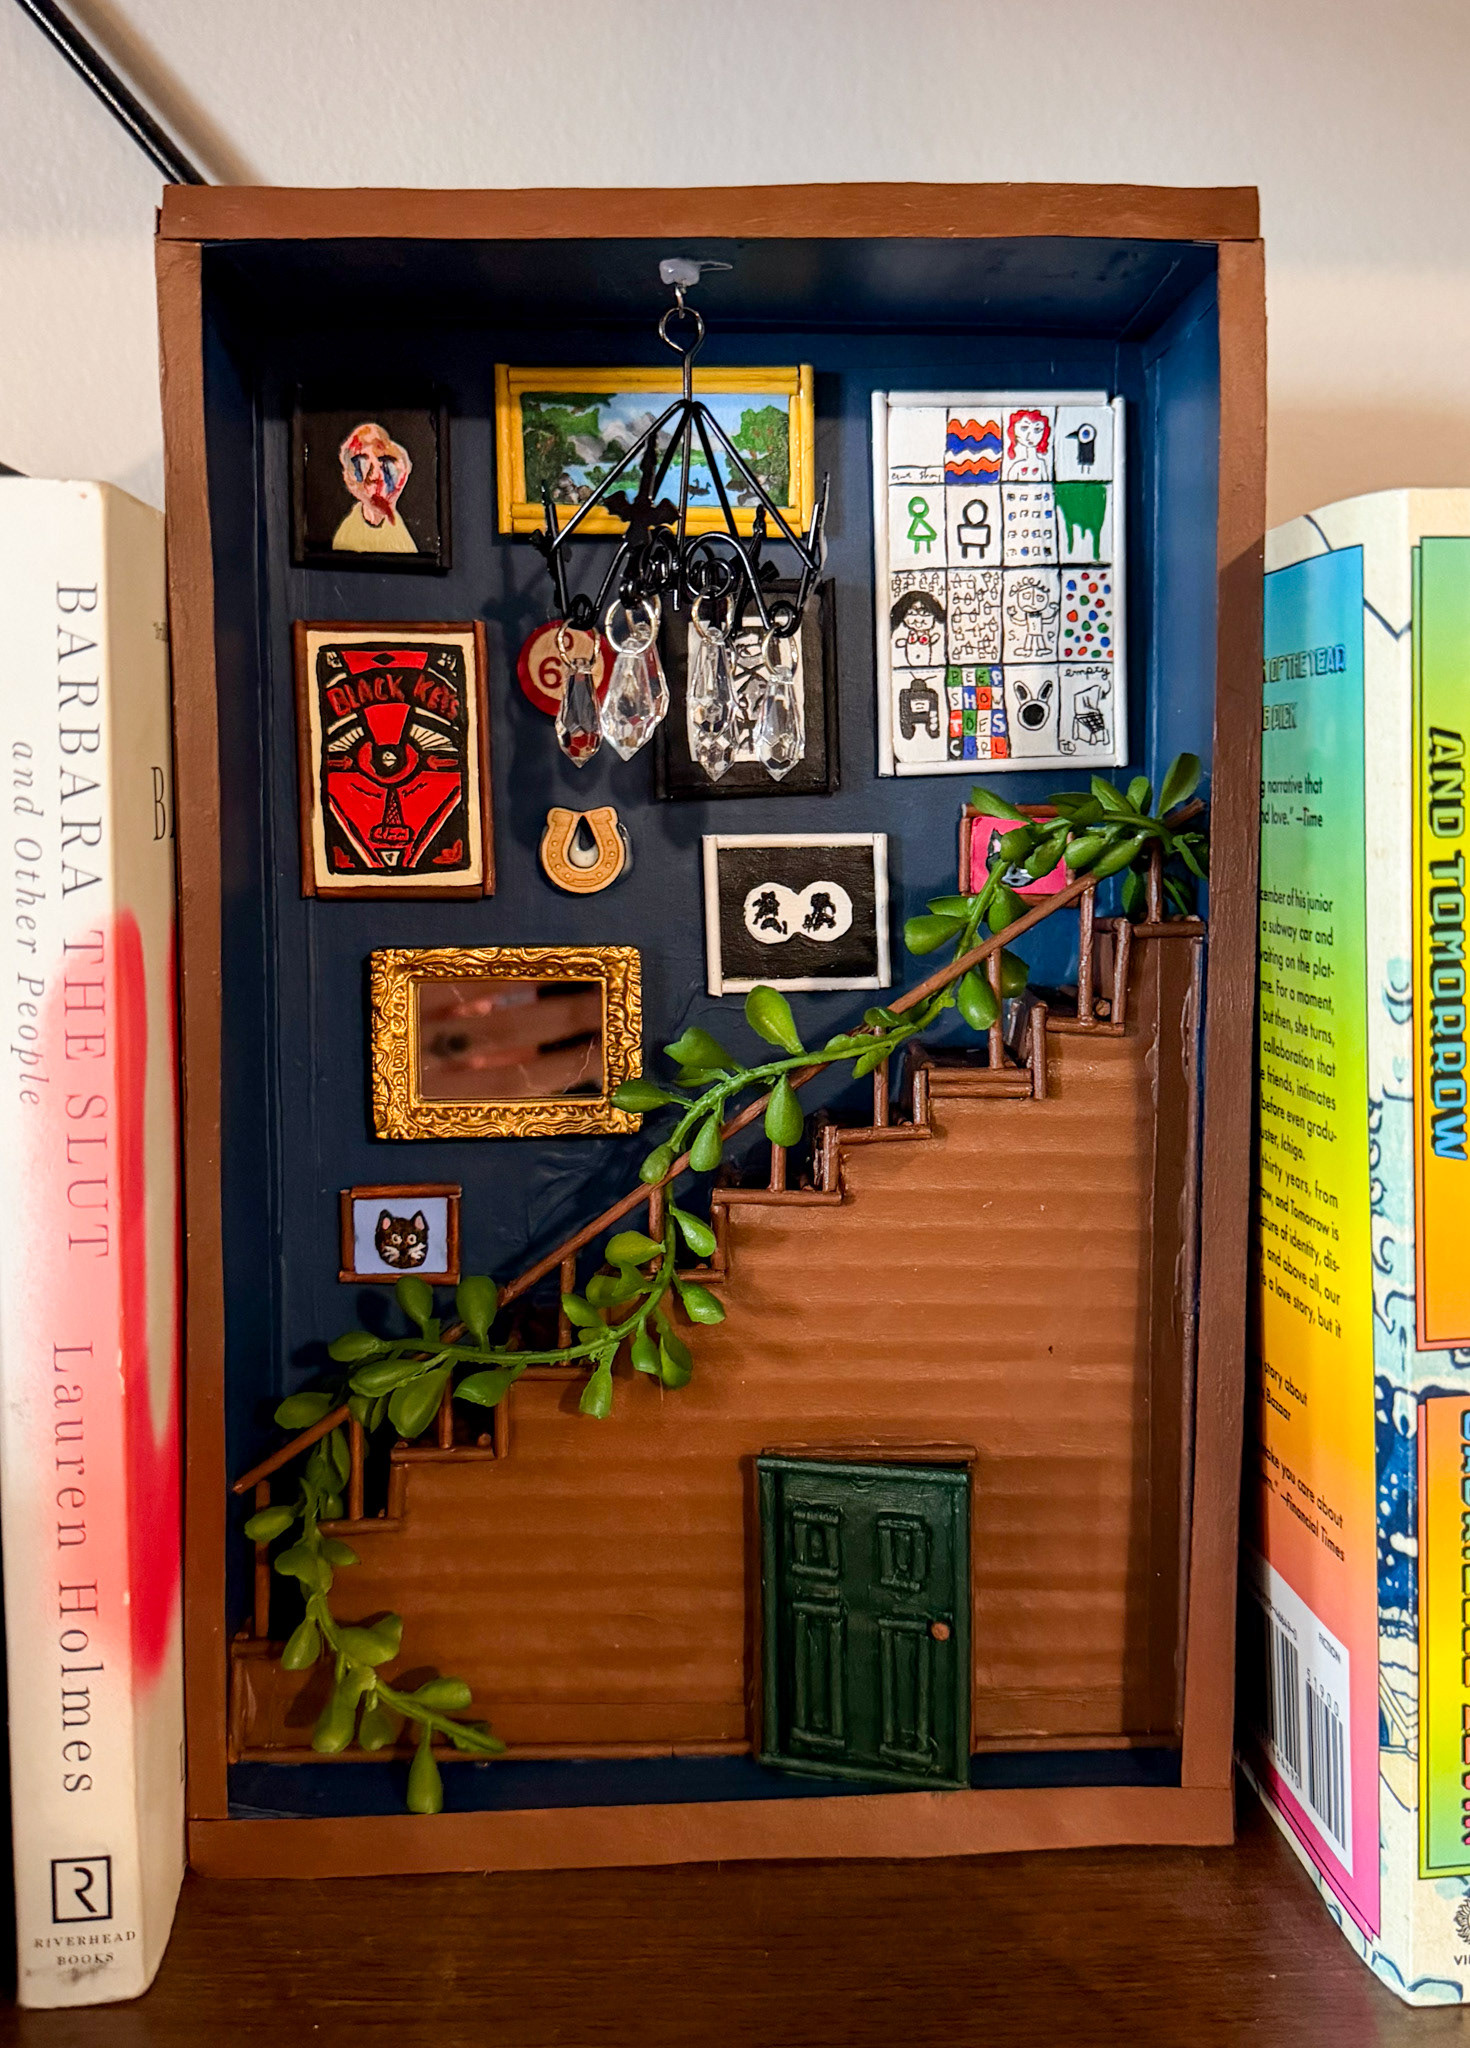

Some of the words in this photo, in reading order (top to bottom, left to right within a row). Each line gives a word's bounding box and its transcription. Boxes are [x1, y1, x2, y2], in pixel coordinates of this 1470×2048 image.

[952, 670, 1002, 686] PEEP
[1064, 666, 1110, 681] empty
[1307, 643, 1346, 676] YEAR
[326, 673, 405, 717] BLACK
[951, 692, 1003, 709] SHOW
[56, 581, 103, 900] BARBARA
[950, 713, 1006, 733] TOES
[949, 739, 1004, 757] CURL
[12, 741, 45, 817] and
[1267, 774, 1303, 794] narrative
[1304, 772, 1323, 794] that
[1428, 726, 1465, 840] AND
[13, 837, 46, 954] Other
[1287, 887, 1295, 906] of
[1307, 891, 1333, 915] junior
[1262, 920, 1267, 932] a
[1269, 916, 1297, 943] subway
[1300, 928, 1312, 942] car
[1315, 926, 1333, 946] and
[1286, 956, 1295, 970] on
[1297, 952, 1310, 974] the
[1313, 957, 1335, 980] plat-
[63, 929, 106, 1061] THE
[1276, 979, 1288, 998] For
[1289, 989, 1295, 1001] a
[1297, 991, 1334, 1015] moment,
[1428, 849, 1468, 1161] TOMORROW
[11, 972, 49, 1106] People
[1262, 1004, 1274, 1024] but
[1274, 1008, 1293, 1034] then,
[1295, 1016, 1308, 1036] she
[1310, 1023, 1335, 1047] turns,
[1263, 1036, 1314, 1070] collaboration
[1317, 1055, 1335, 1078] that
[1267, 1065, 1295, 1096] friends,
[1297, 1079, 1336, 1111] intimates
[1261, 1094, 1285, 1120] before
[1286, 1111, 1305, 1129] even
[1307, 1120, 1337, 1142] gradu-
[1281, 1133, 1305, 1161] Ichigo.
[65, 1094, 110, 1257] SLUT
[1261, 1153, 1282, 1183] thirty
[1286, 1170, 1311, 1198] years,
[1315, 1179, 1338, 1208] from
[1275, 1195, 1289, 1212] and
[1290, 1199, 1330, 1236] Tomorrow
[1331, 1221, 1339, 1241] is
[1280, 1224, 1288, 1242] of
[1289, 1228, 1321, 1267] identity,
[1323, 1249, 1340, 1272] dis-
[1267, 1249, 1281, 1267] and
[1283, 1255, 1307, 1285] above
[1309, 1273, 1322, 1297] all,
[1324, 1287, 1341, 1305] our
[1268, 1279, 1274, 1291] a
[1275, 1277, 1291, 1304] love
[1293, 1296, 1316, 1325] story,
[1318, 1306, 1332, 1333] but
[1335, 1319, 1341, 1339] it
[1264, 1362, 1282, 1390] story
[1284, 1376, 1307, 1408] about
[1266, 1387, 1291, 1421] Bazaar
[53, 1340, 94, 1550] Lauren
[1281, 1462, 1296, 1485] you
[1297, 1479, 1315, 1503] care
[1316, 1494, 1343, 1529] about
[1321, 1525, 1345, 1562] Times
[58, 1579, 104, 1793] Holmes
[73, 1866, 97, 1913] R
[33, 1930, 136, 1949] RIVERHEAD
[56, 1951, 114, 1966] BOOKS
